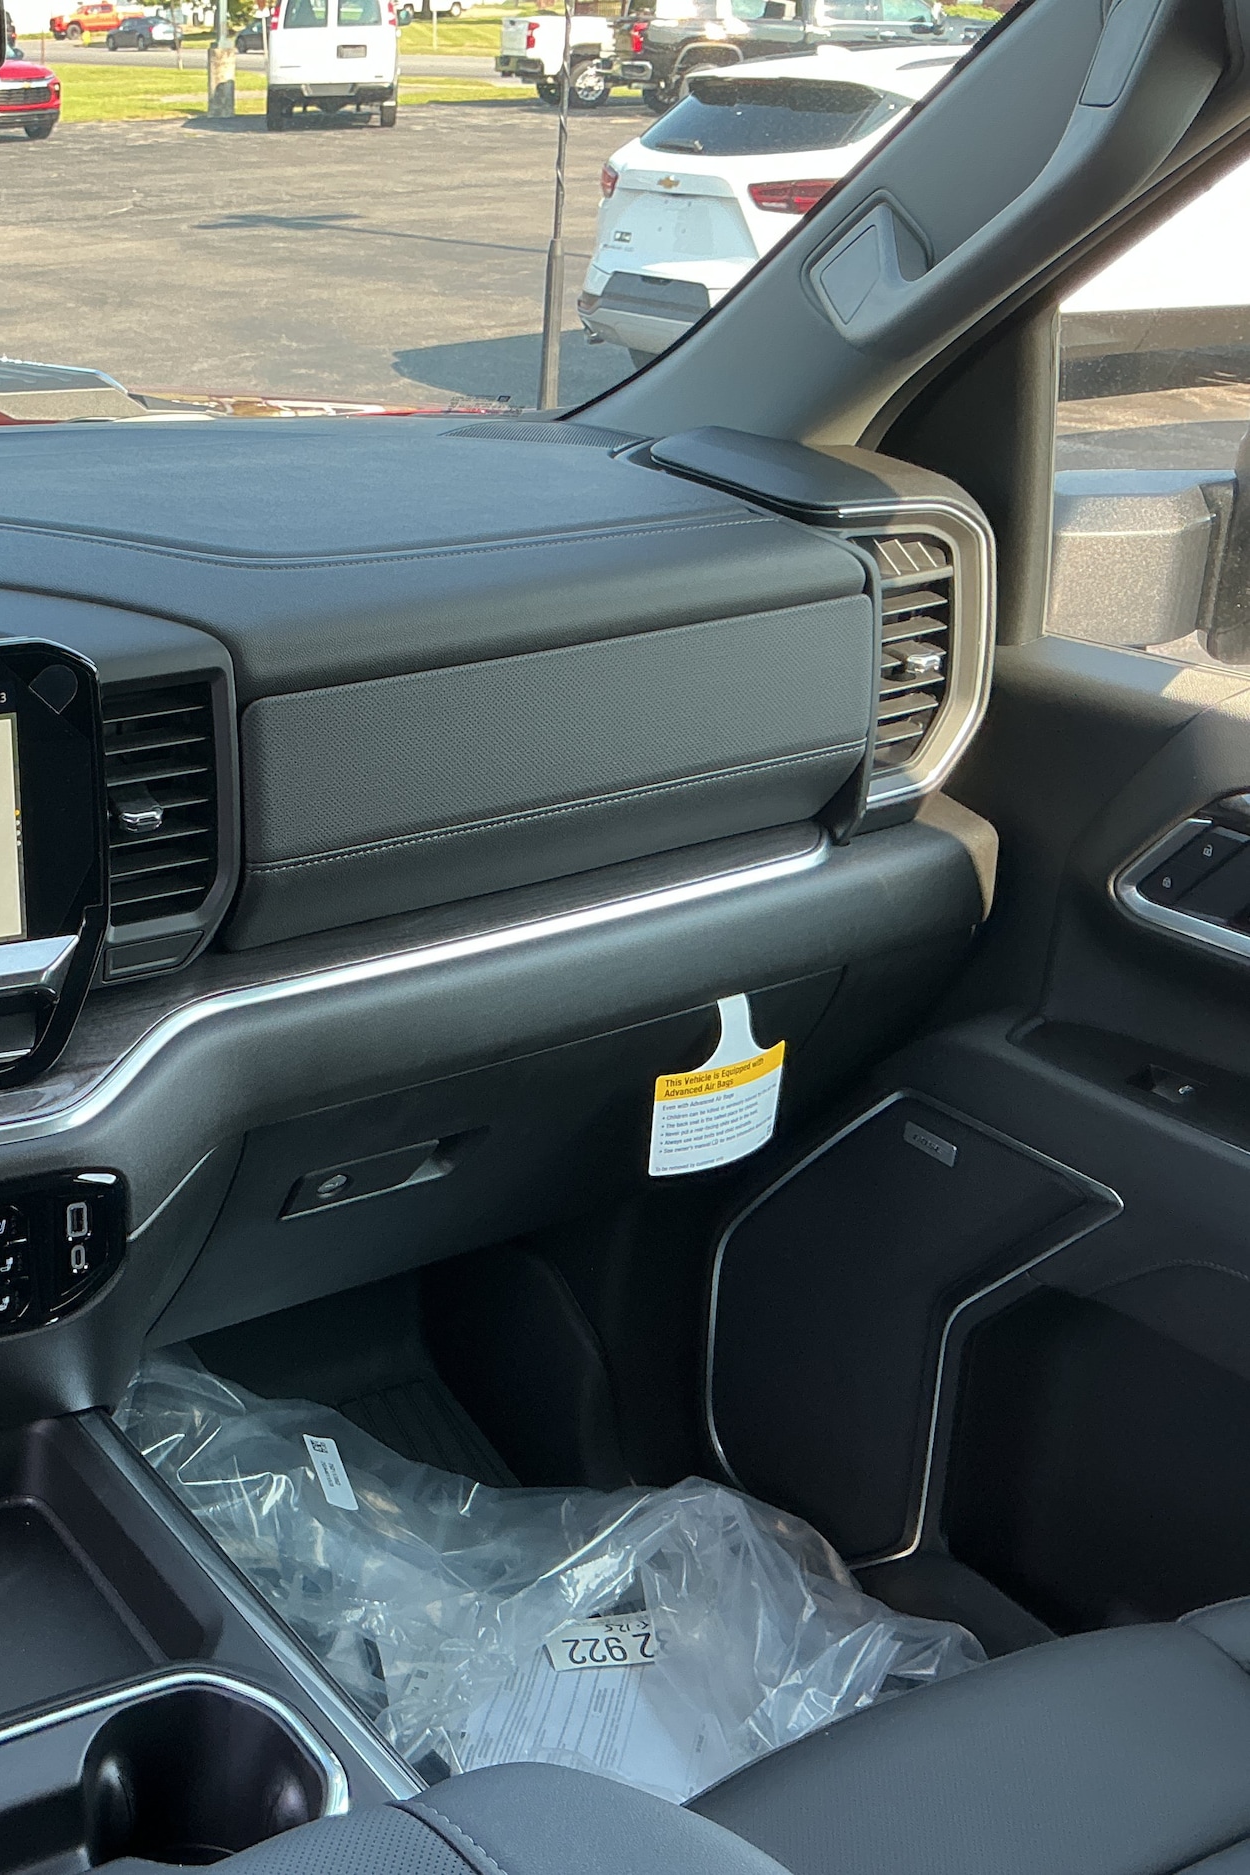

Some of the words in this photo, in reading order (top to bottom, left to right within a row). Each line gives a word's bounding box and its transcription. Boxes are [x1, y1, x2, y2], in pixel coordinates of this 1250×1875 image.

[664, 1078, 683, 1087] This
[684, 1073, 712, 1086] Vehicle
[714, 1071, 720, 1080] is
[721, 1061, 751, 1078] Equipped
[752, 1057, 764, 1068] with
[664, 1084, 703, 1097] Advanced
[704, 1082, 716, 1092] Air
[717, 1079, 734, 1089] Bags
